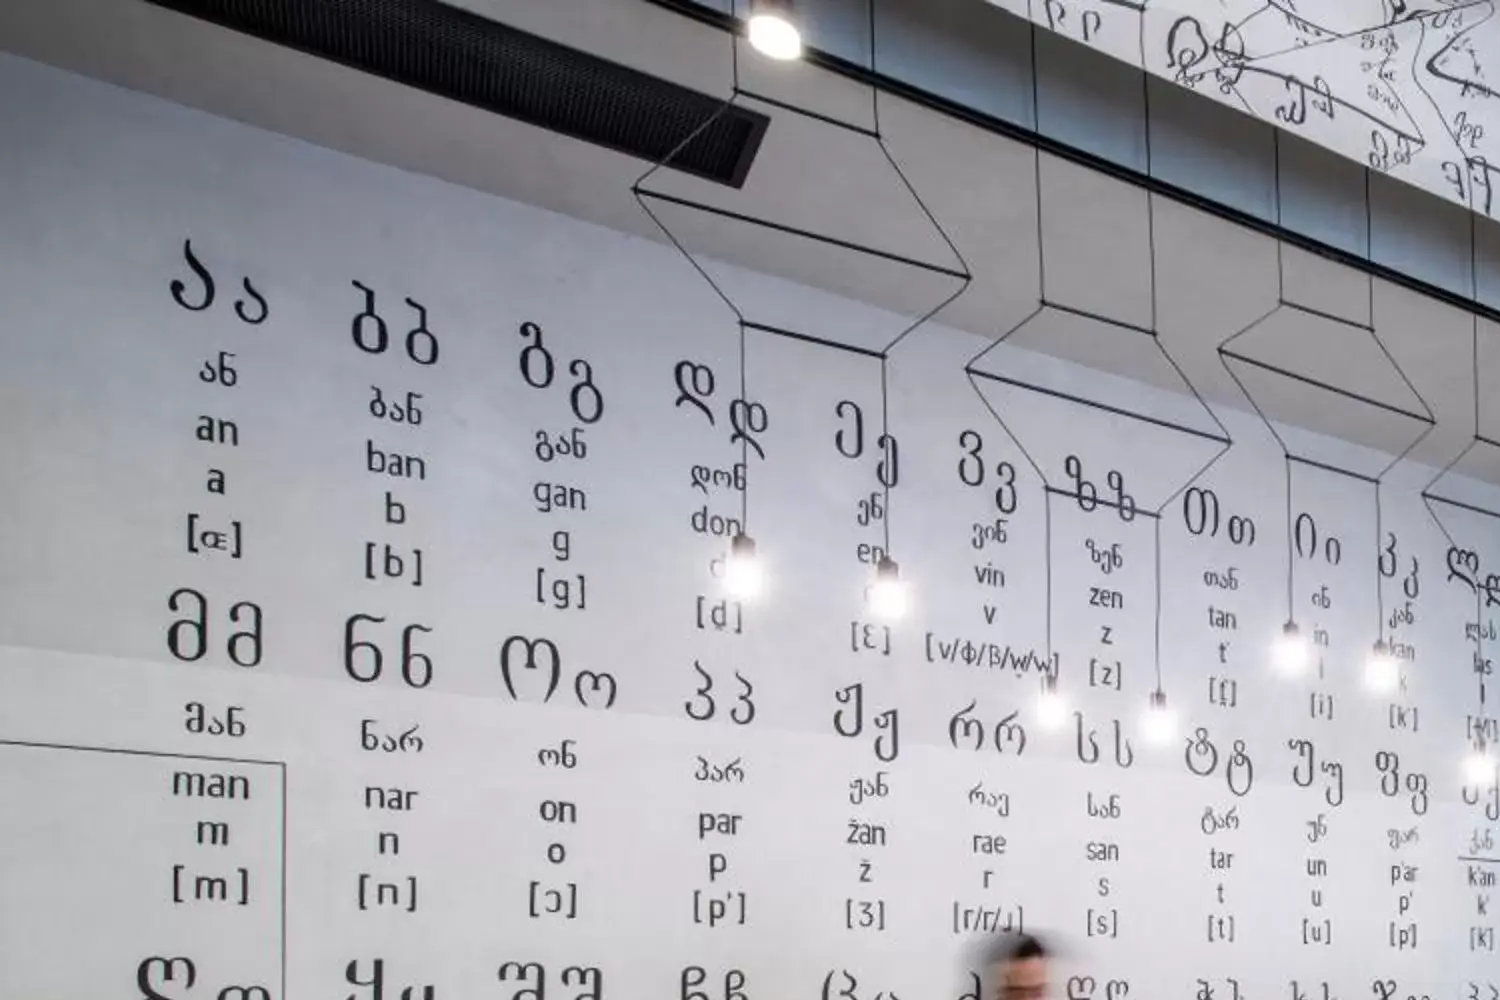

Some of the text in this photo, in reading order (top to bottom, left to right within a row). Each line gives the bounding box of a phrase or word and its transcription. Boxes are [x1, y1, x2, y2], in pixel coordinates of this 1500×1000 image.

[199, 352, 237, 386] ან
[370, 386, 423, 425] ბან
[196, 415, 238, 446] an
[536, 429, 587, 462] გან
[367, 440, 425, 480] ban
[207, 469, 225, 495] a
[691, 464, 747, 494] დონ
[385, 492, 406, 525] b
[534, 481, 587, 511] gan
[857, 493, 883, 526] ენ
[691, 508, 741, 538] don
[972, 520, 1007, 549] ვინ
[553, 530, 570, 561] g
[857, 544, 884, 565] en
[1085, 539, 1123, 574] ზენ
[365, 542, 423, 586] [b]
[974, 562, 1005, 588] vin
[536, 568, 586, 609] [g]
[1204, 569, 1239, 591] თან
[1089, 587, 1123, 610] zen
[1311, 591, 1331, 610] ინ
[983, 604, 996, 625] v
[1209, 608, 1237, 631] tan
[1101, 625, 1113, 644] z
[1312, 625, 1329, 647] in
[1090, 661, 1121, 690] [z]
[185, 702, 246, 738] მან
[361, 719, 424, 753] ნარ
[538, 740, 577, 769] ონ
[694, 756, 744, 783] პარ
[172, 771, 250, 801] man
[365, 785, 418, 811] nar
[850, 772, 889, 804] ჟან
[969, 782, 1009, 817] რაე
[540, 800, 577, 823] on
[1087, 792, 1121, 818] სან
[197, 821, 228, 846] m
[699, 812, 742, 839] par
[847, 820, 886, 846] žan
[1201, 807, 1239, 835] ტარ
[1307, 815, 1327, 843] უნ
[379, 832, 399, 855] n
[547, 843, 565, 864] o
[973, 832, 1007, 855] rae
[1086, 842, 1119, 861] san
[710, 852, 726, 882] p
[859, 859, 872, 883] ž
[1210, 849, 1234, 870] tar
[1307, 859, 1327, 877] un
[173, 865, 249, 906] [m]
[982, 869, 993, 889] r
[1098, 877, 1109, 896] s
[359, 874, 417, 913] [n]
[1217, 884, 1224, 904] t
[1312, 890, 1322, 907] u
[1087, 909, 1117, 938] [s]
